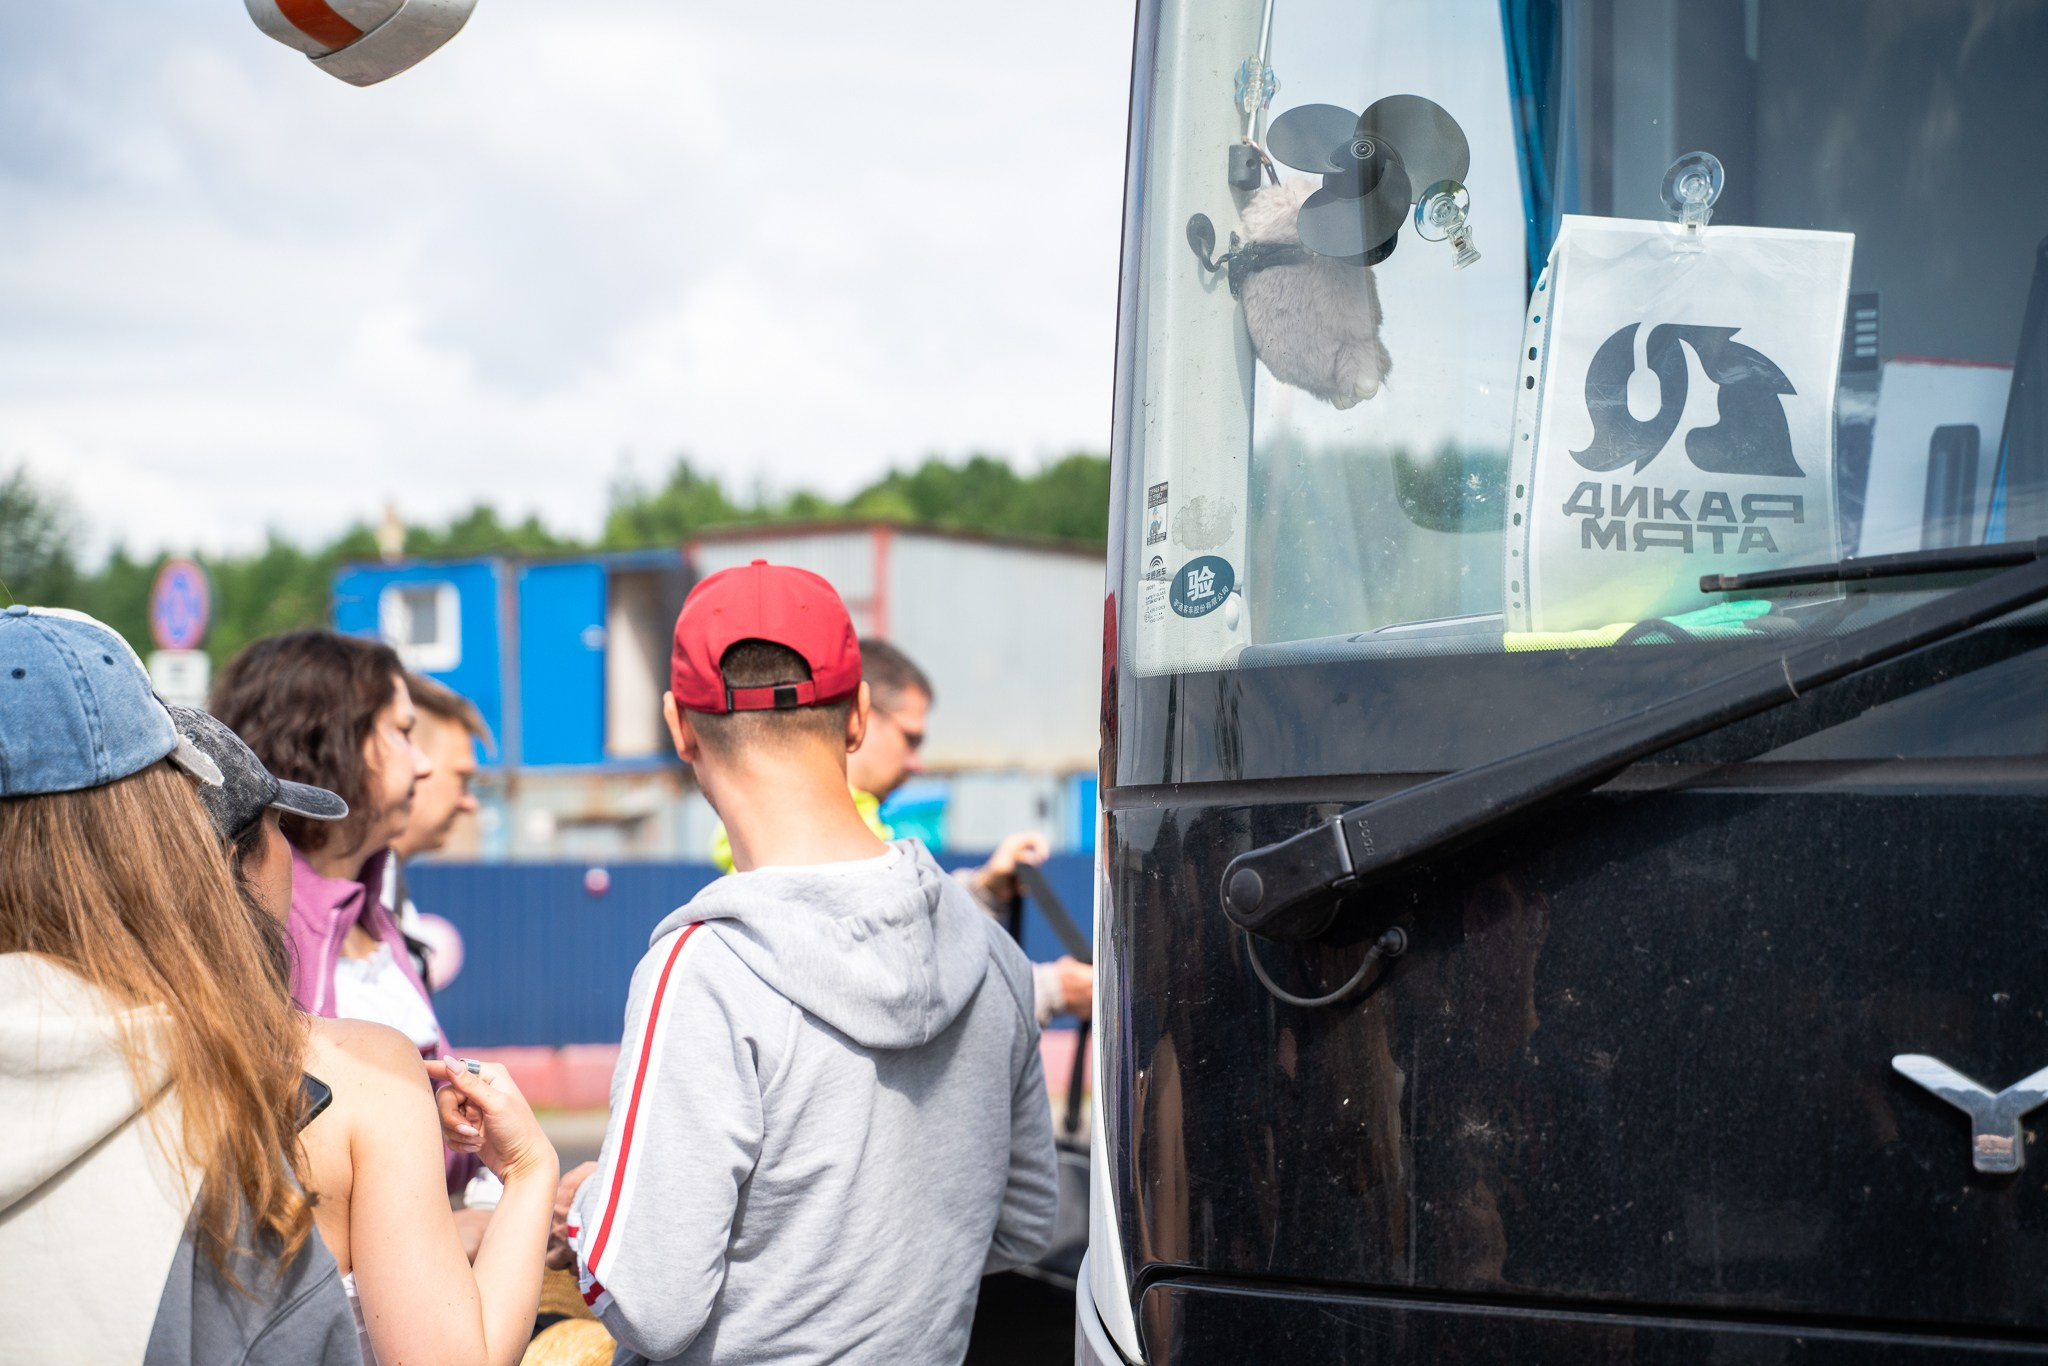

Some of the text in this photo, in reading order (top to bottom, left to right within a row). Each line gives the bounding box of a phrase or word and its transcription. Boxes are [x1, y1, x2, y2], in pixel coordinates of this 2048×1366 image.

[1562, 481, 1805, 524] ДИКАЯ
[1581, 518, 1779, 554] МЯТА
[1187, 565, 1216, 602] 验
